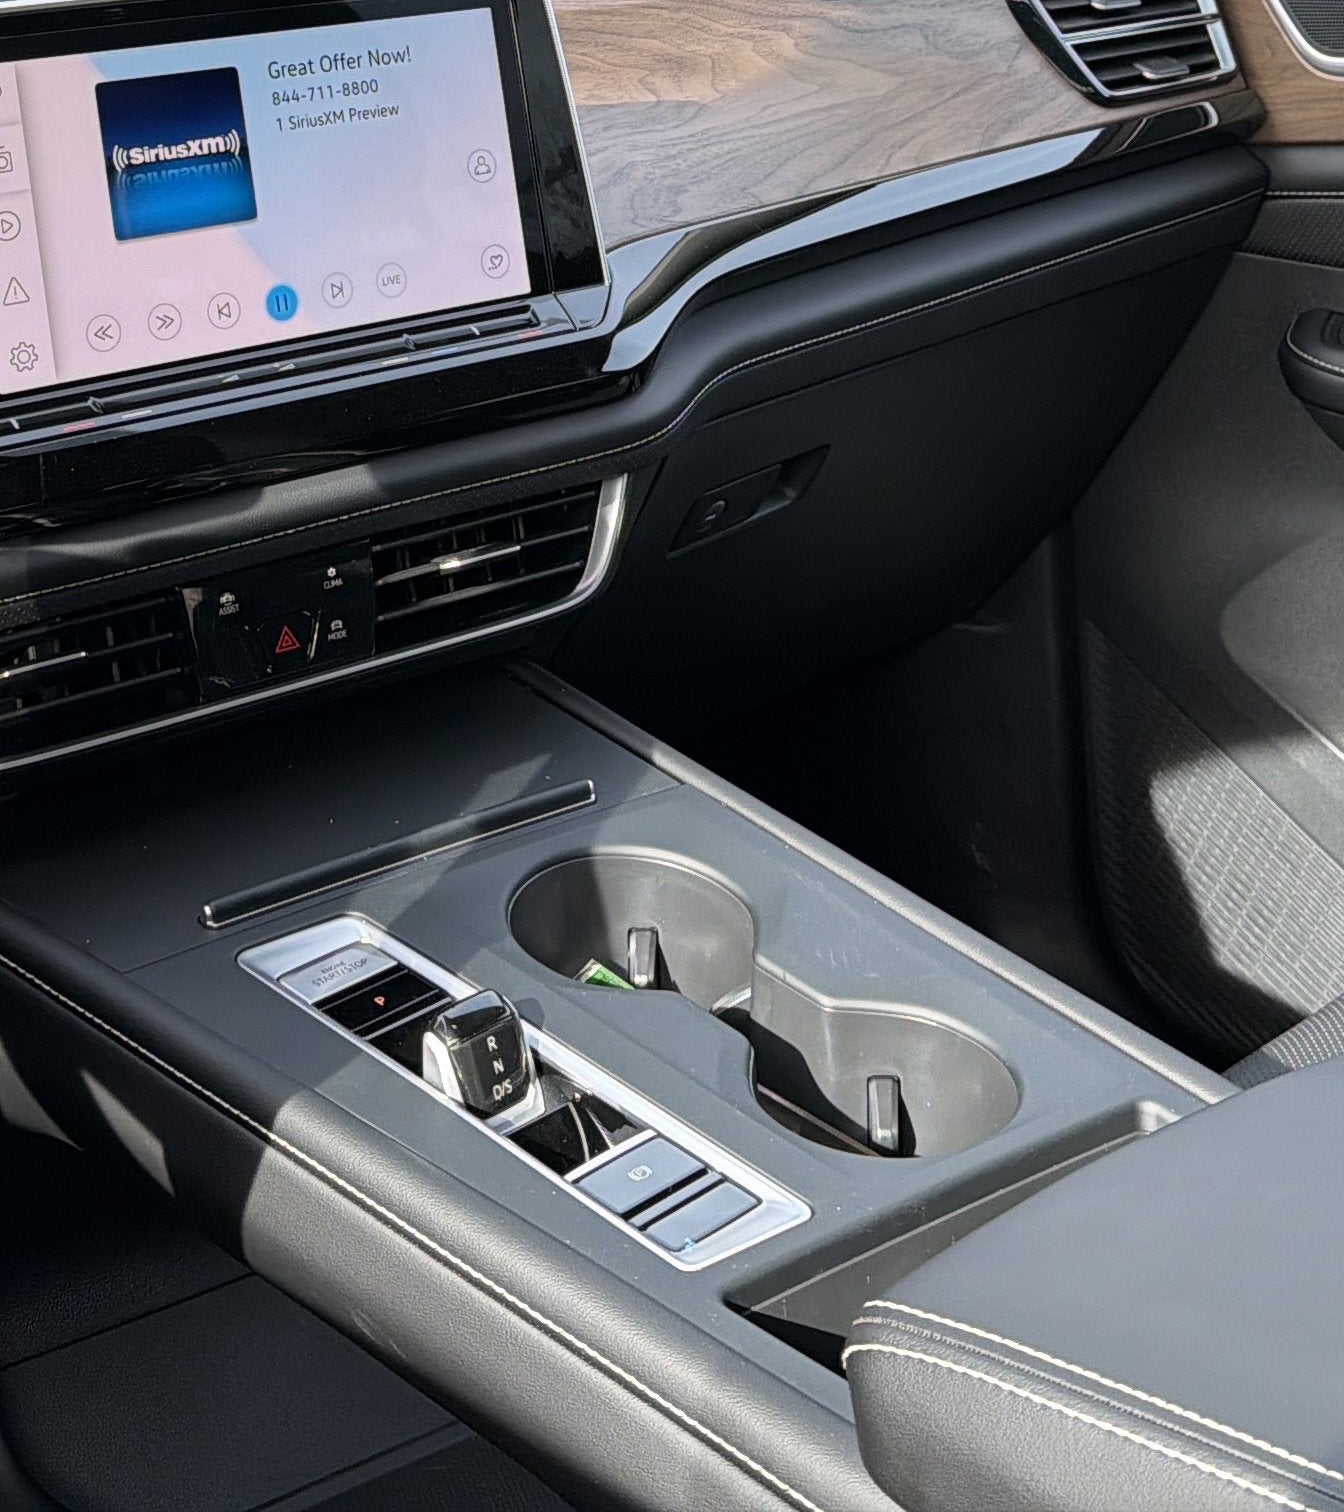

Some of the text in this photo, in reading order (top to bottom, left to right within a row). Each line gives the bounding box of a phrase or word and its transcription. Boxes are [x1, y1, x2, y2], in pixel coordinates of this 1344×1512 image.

[268, 45, 412, 79] Great Offer Now!
[272, 78, 379, 106] 844-711-8800
[276, 104, 400, 132] 1 SiriusXM Preview
[381, 273, 402, 288] LIVE
[323, 578, 344, 590] CLIMA
[218, 603, 240, 616] ASSIST
[328, 629, 348, 642] MODE
[312, 958, 367, 987] START/STOP
[486, 1035, 498, 1052] R
[493, 1059, 505, 1076] N
[492, 1078, 513, 1101] D/S
